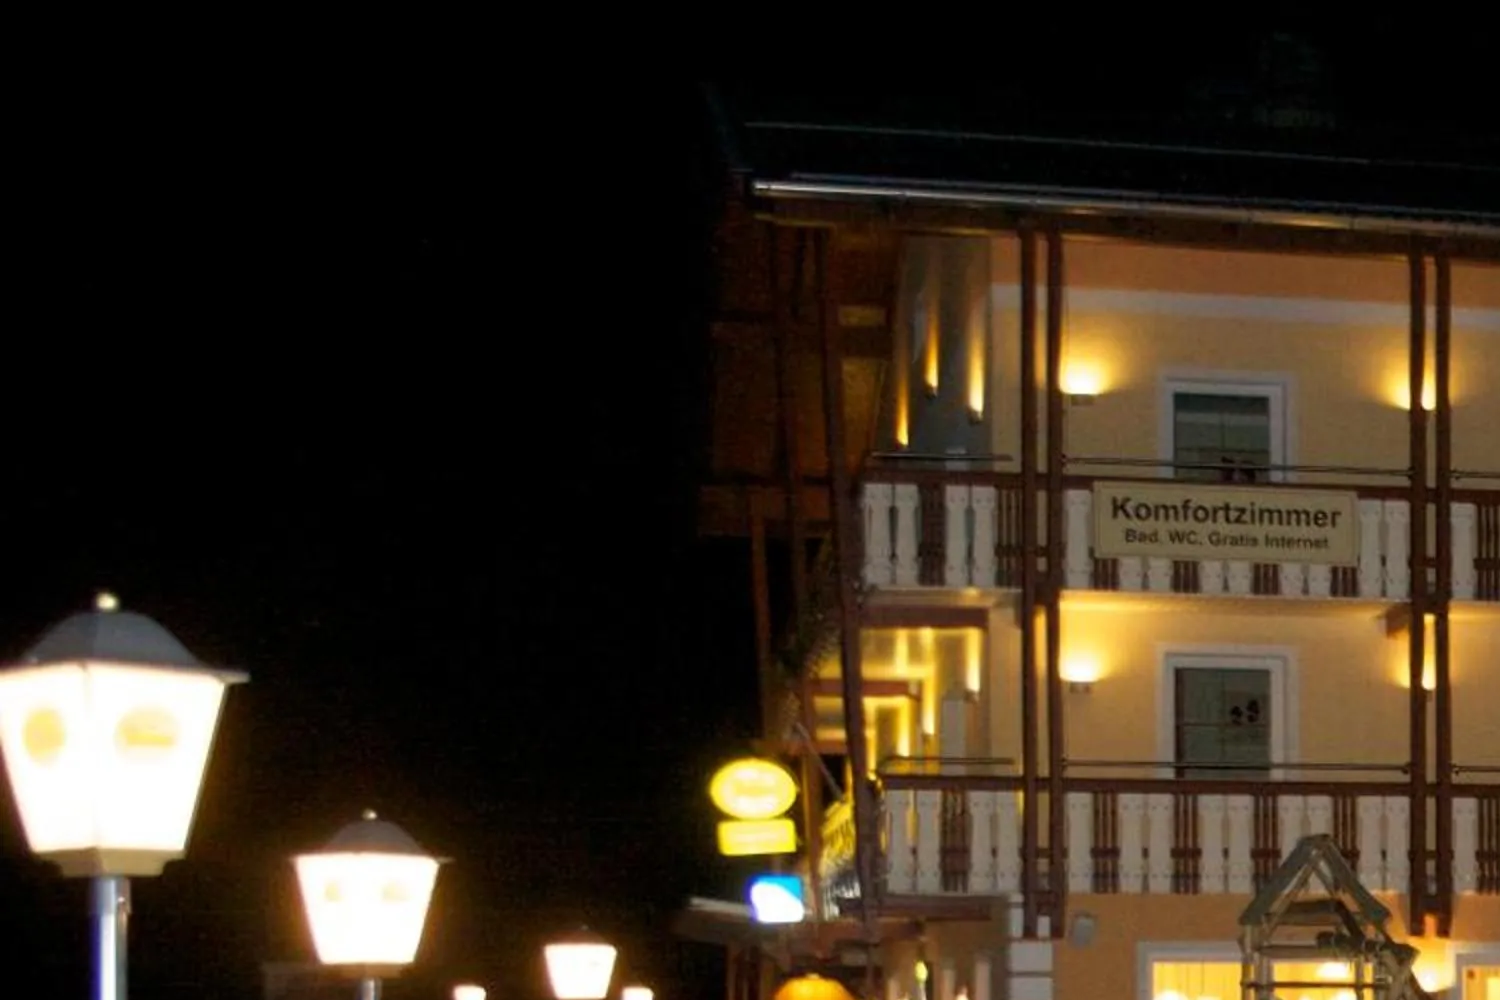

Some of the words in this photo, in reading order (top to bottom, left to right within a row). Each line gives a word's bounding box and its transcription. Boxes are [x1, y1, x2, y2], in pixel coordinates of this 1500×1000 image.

[1111, 496, 1341, 528] Komfortzimmer
[1208, 531, 1259, 548] Gratis
[1265, 533, 1329, 550] Internet
